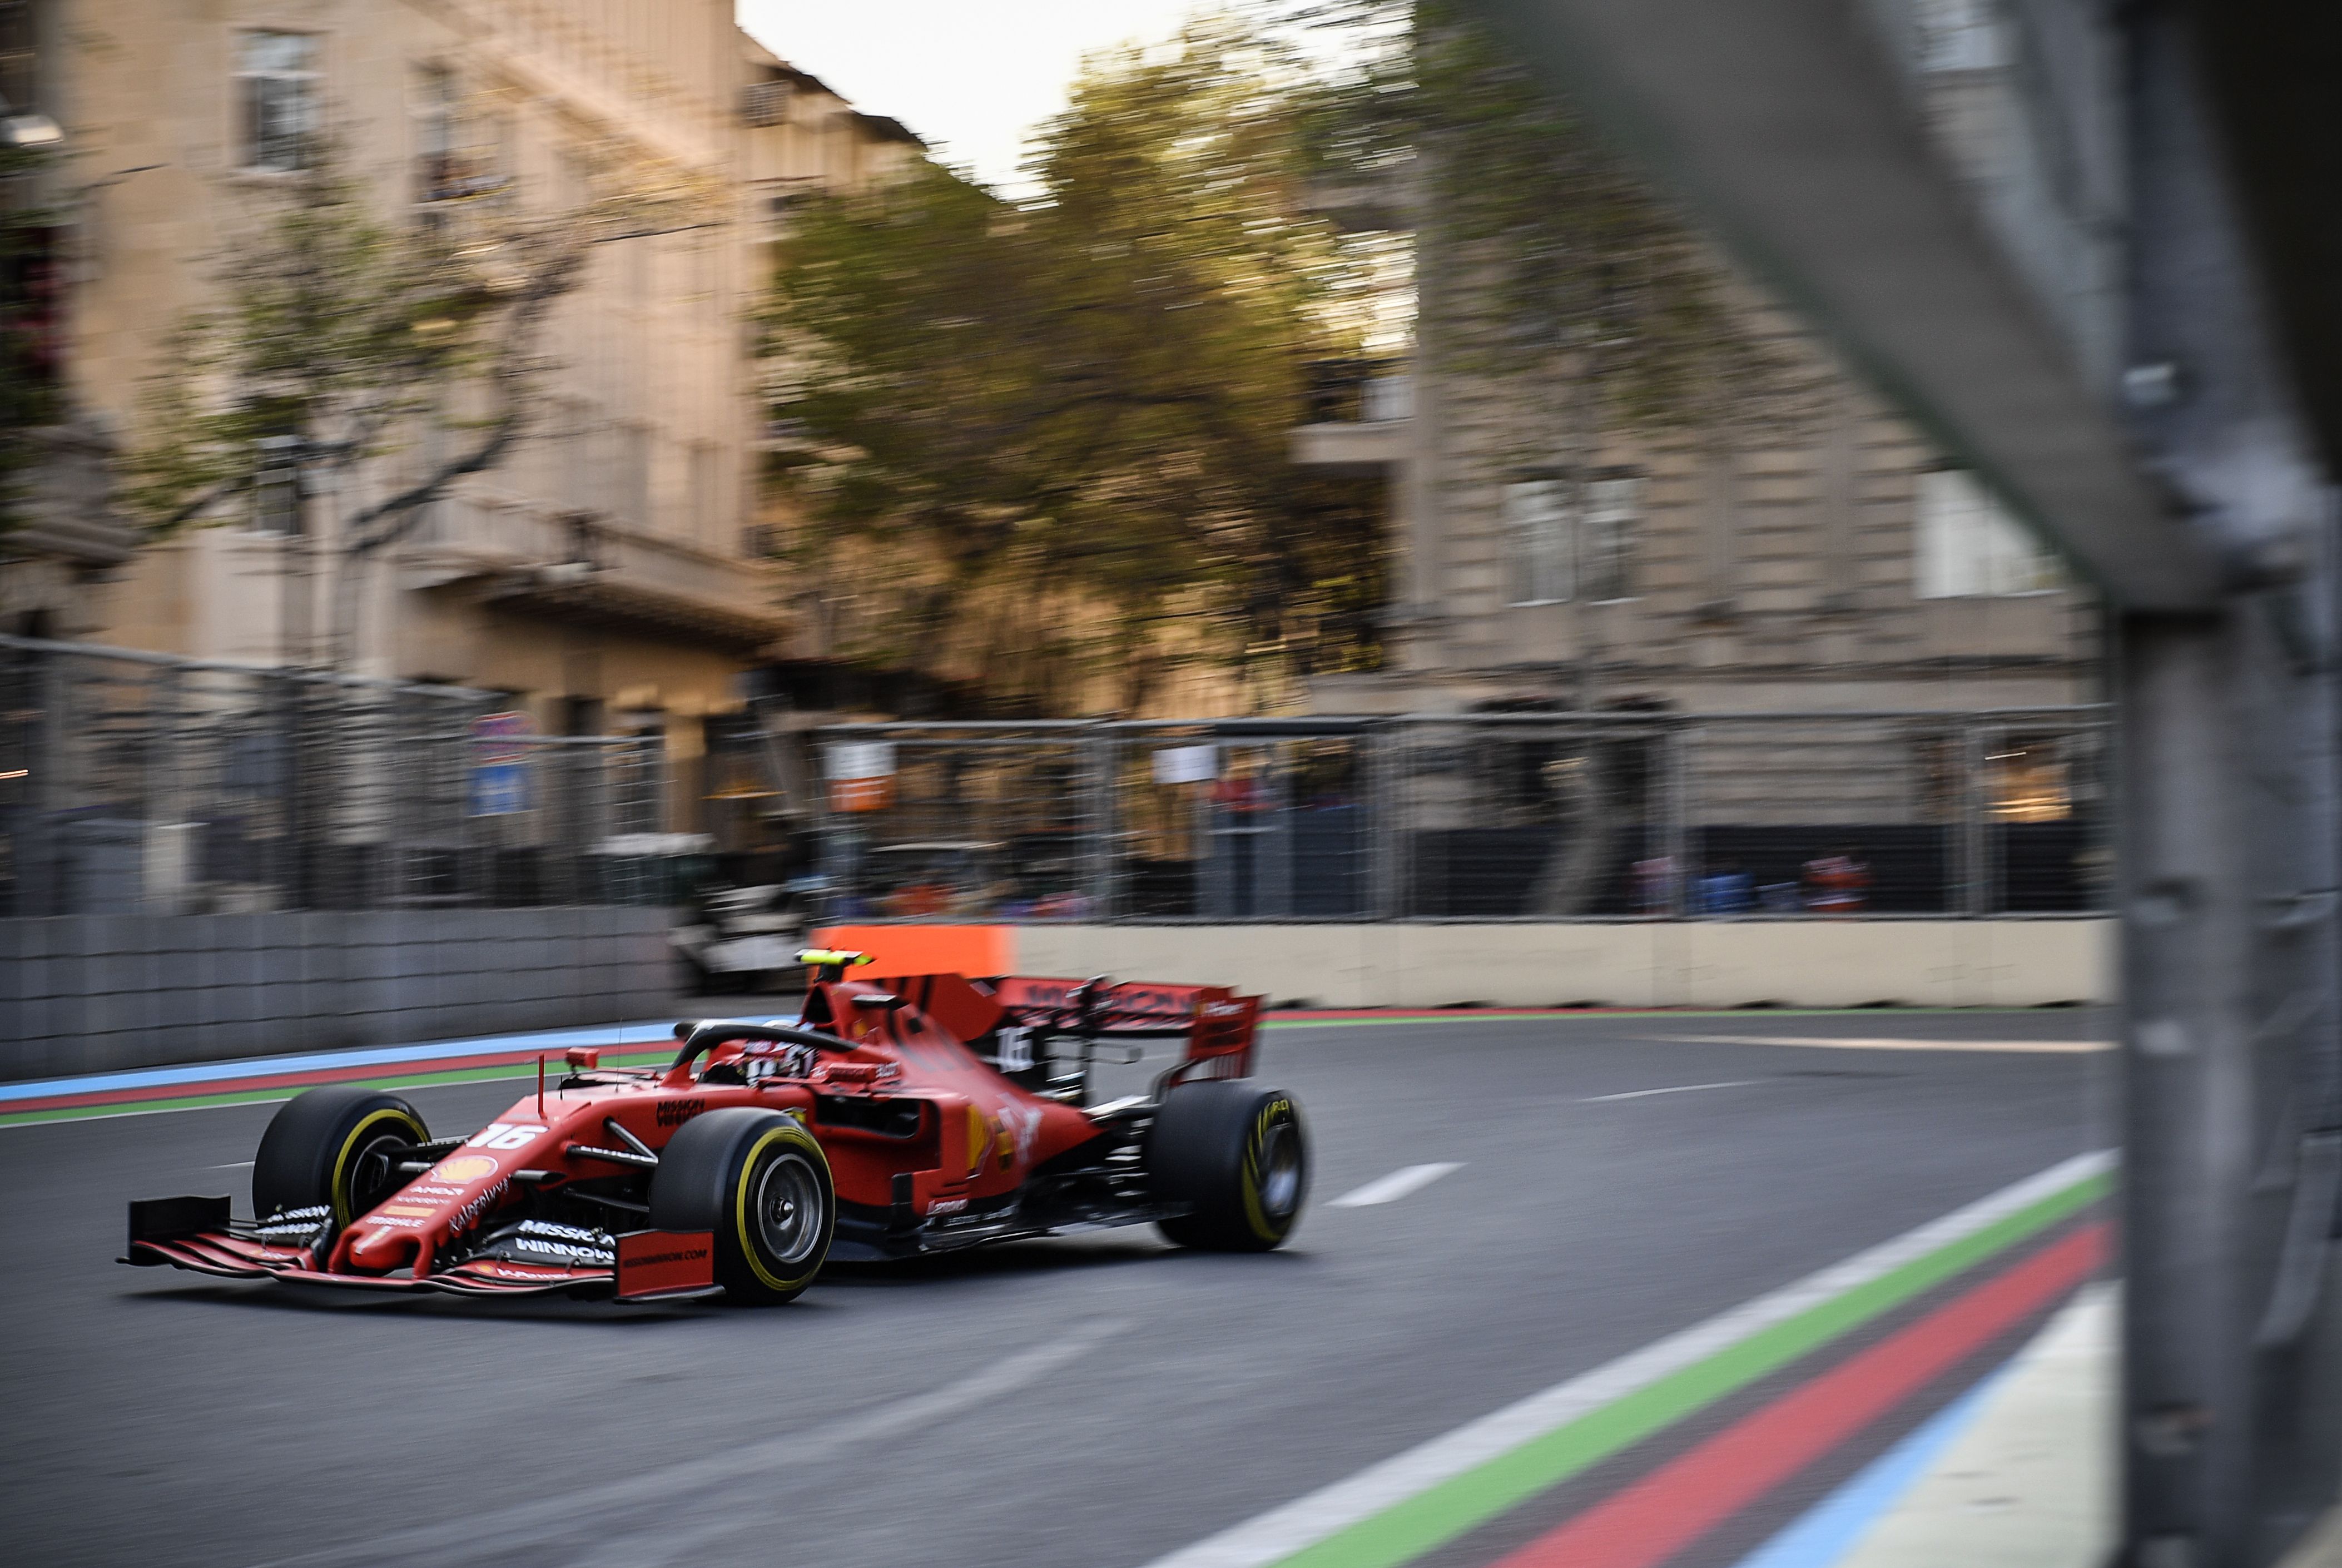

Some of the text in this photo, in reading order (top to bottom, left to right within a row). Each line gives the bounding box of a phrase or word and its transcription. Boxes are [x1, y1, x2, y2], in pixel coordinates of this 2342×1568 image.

[657, 1099, 705, 1115] MISSION
[466, 1123, 549, 1149] 16
[515, 1237, 616, 1260] WINNOW
